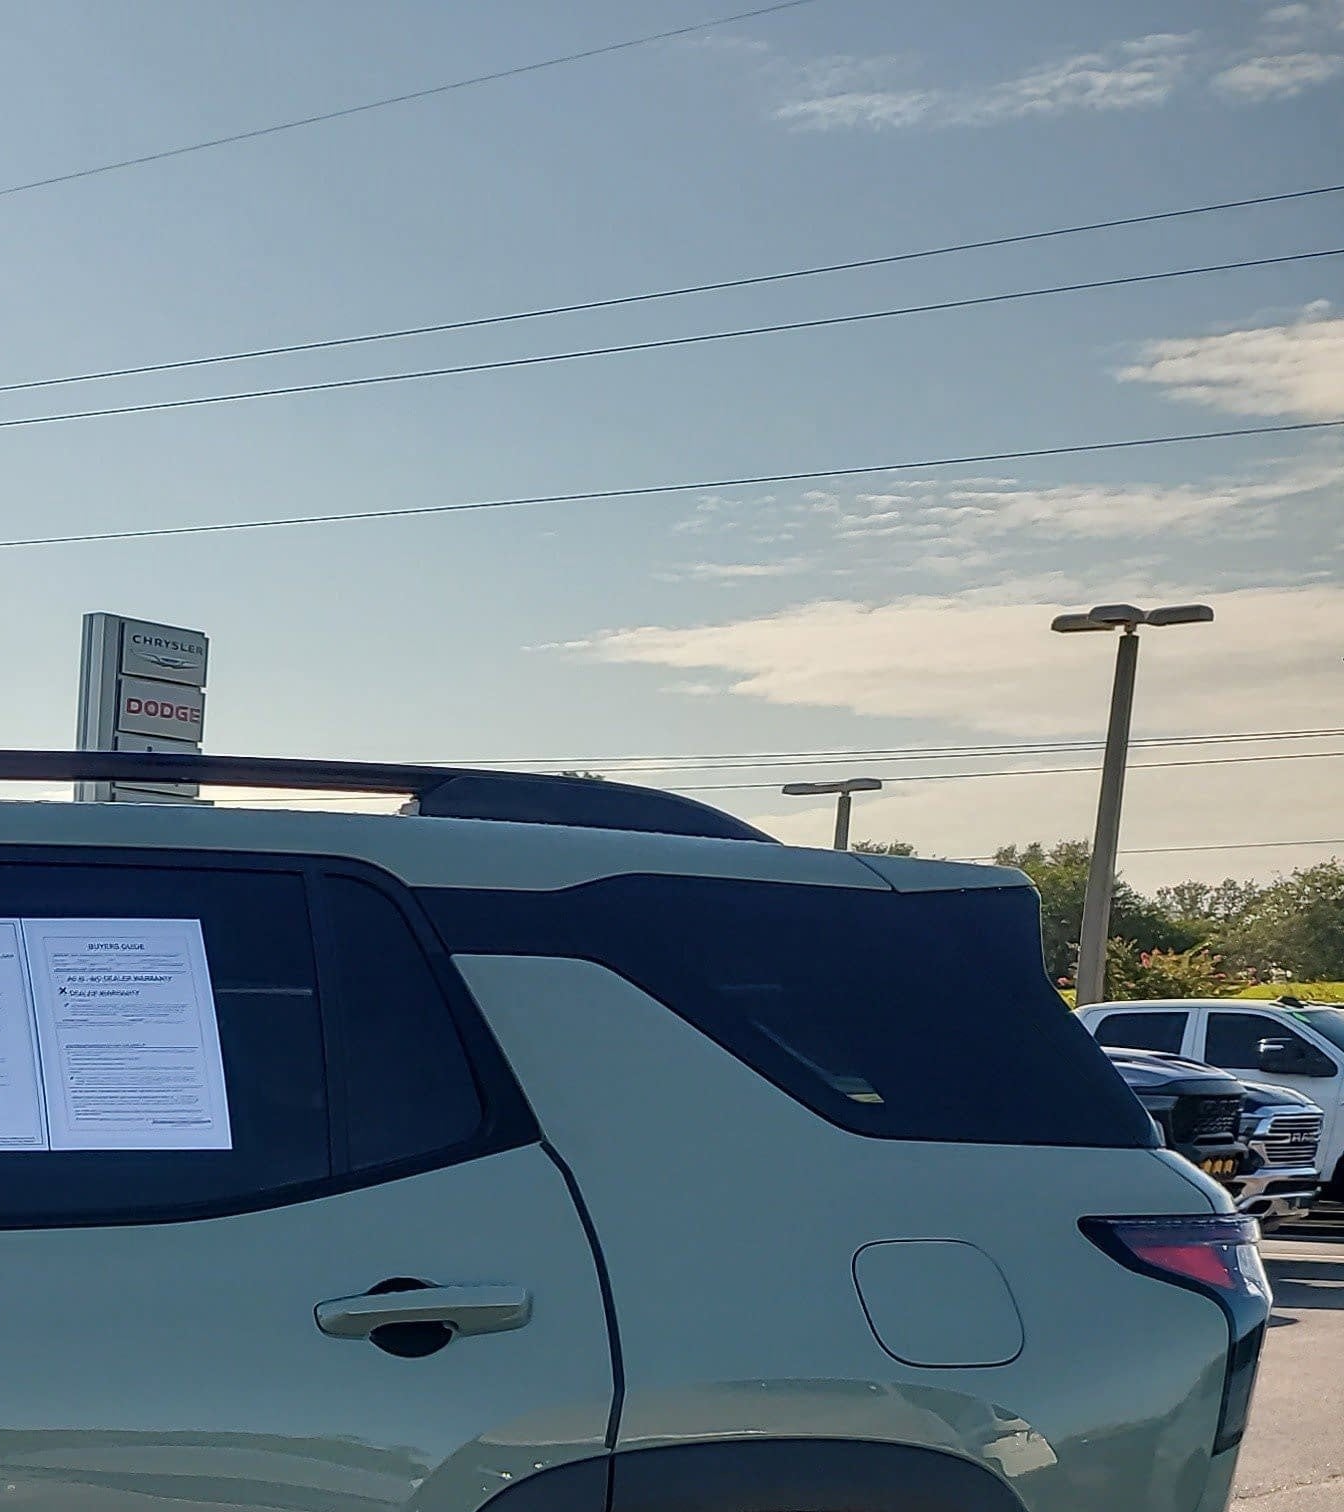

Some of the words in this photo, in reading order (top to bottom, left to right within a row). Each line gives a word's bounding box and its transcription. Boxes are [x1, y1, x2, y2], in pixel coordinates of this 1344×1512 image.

[132, 634, 203, 656] CHRYSLER
[126, 697, 201, 723] DODGE
[88, 943, 120, 951] BUYERS
